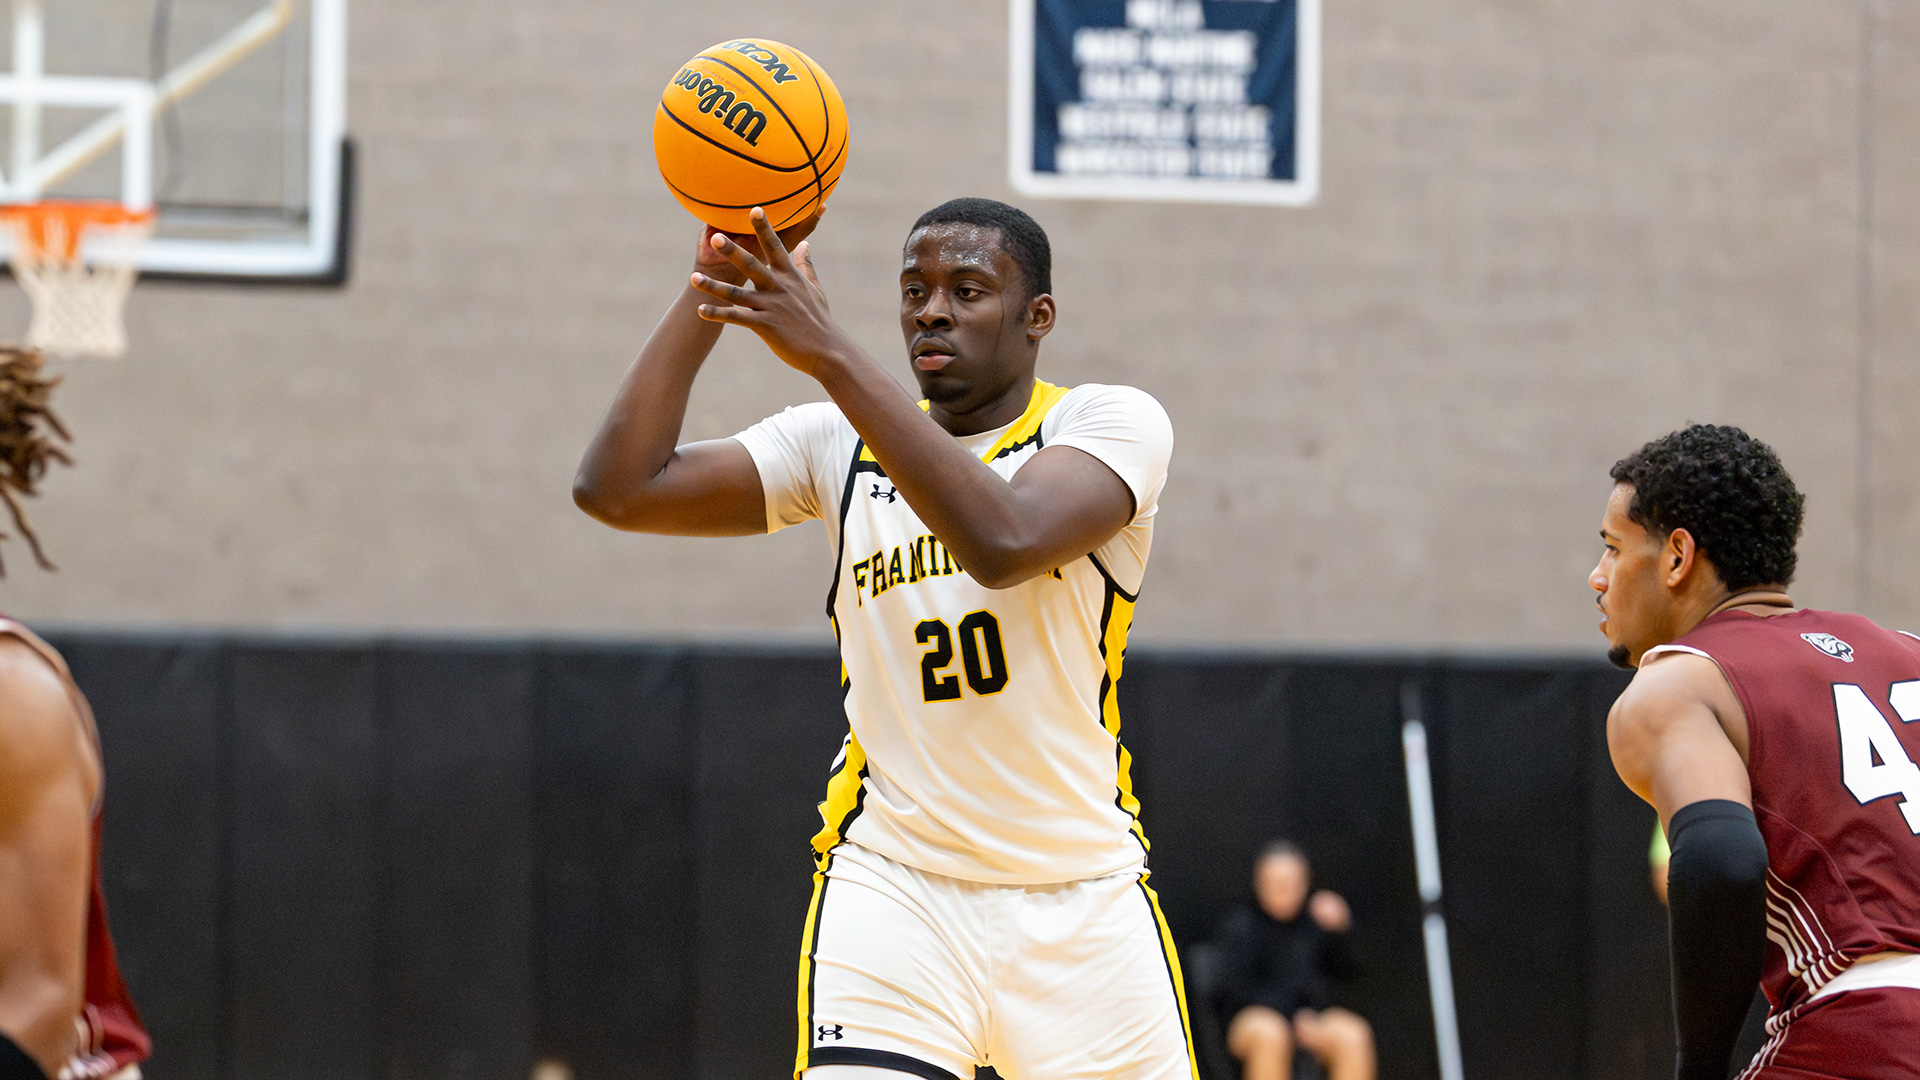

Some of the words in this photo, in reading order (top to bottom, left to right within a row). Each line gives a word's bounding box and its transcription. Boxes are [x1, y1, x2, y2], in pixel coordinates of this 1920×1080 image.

[722, 41, 799, 84] NCAA
[675, 67, 767, 147] Wilson
[852, 534, 1063, 608] FRAMIN
[914, 609, 1010, 704] 20
